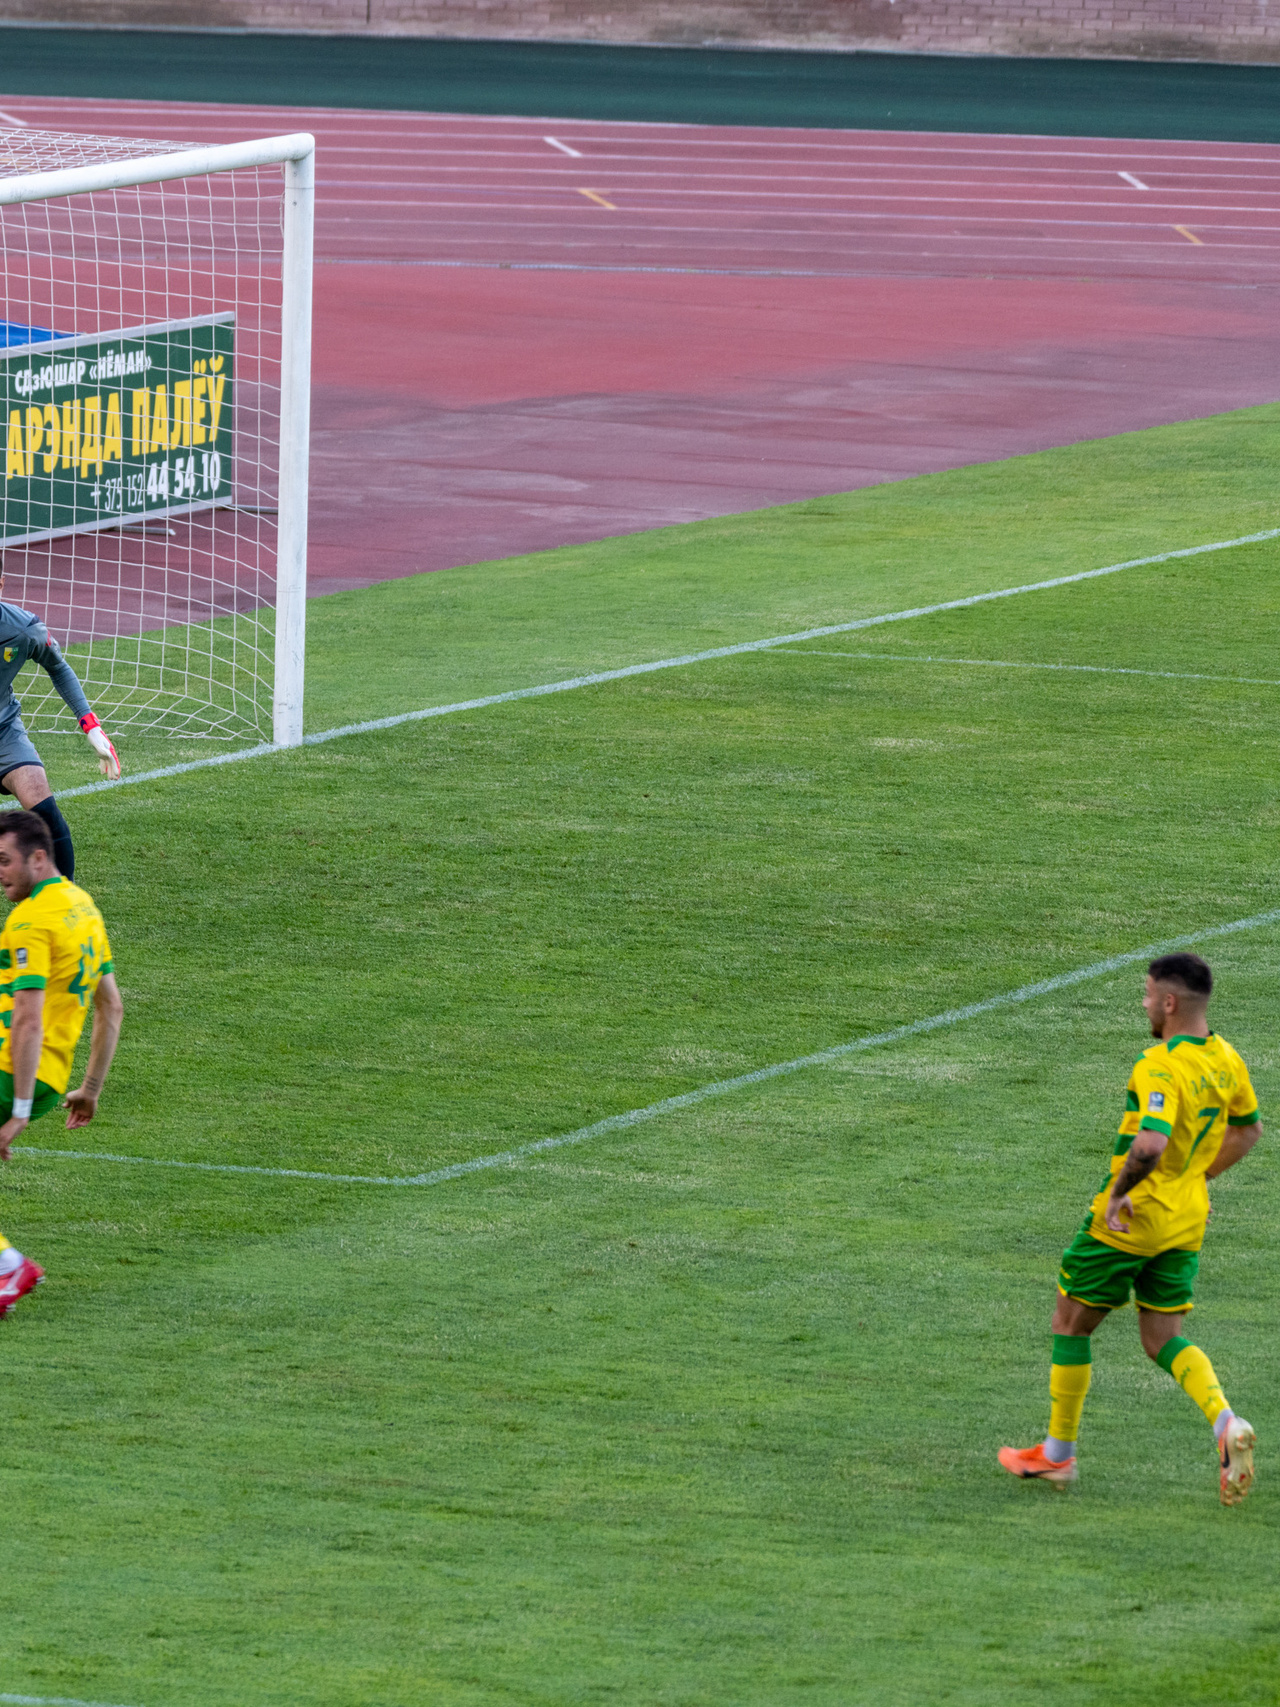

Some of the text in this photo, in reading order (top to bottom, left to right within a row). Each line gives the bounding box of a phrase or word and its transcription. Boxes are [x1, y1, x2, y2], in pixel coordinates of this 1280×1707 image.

[6, 355, 226, 480] АРЭНДА ПАЛЁЎ
[147, 460, 169, 502] 44
[174, 455, 195, 497] 54
[201, 451, 221, 493] 10
[1181, 1107, 1220, 1178] 7
